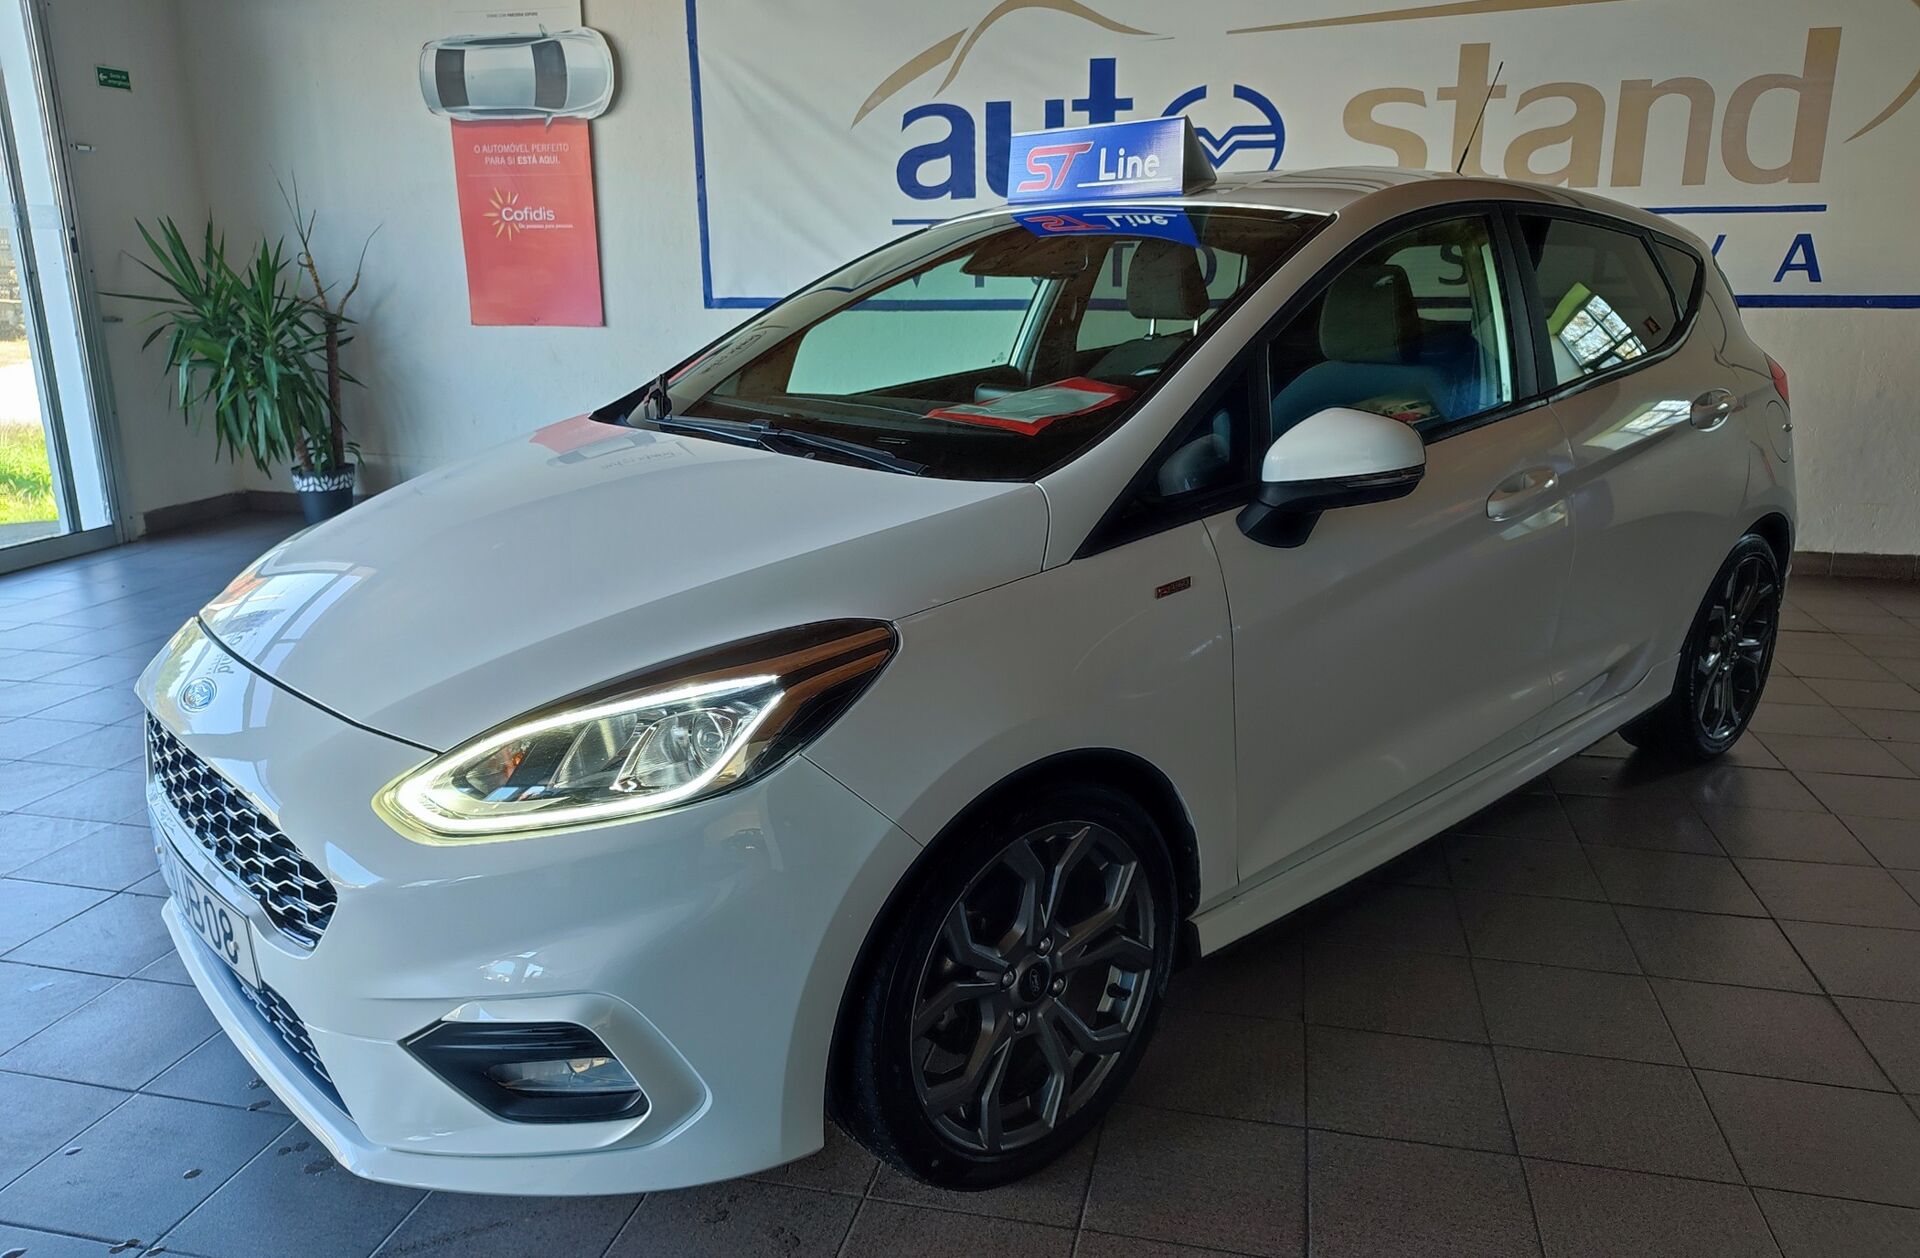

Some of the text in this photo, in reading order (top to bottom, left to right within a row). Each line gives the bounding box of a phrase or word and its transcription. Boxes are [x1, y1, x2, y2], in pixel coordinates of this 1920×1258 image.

[1342, 27, 1842, 188] stand
[473, 142, 570, 154] O AUTOMÓVEL PERFEITO
[484, 156, 506, 165] PARA
[517, 153, 538, 165] ESTÁ
[1016, 140, 1161, 193] ST Line
[501, 206, 555, 221] Cofidis
